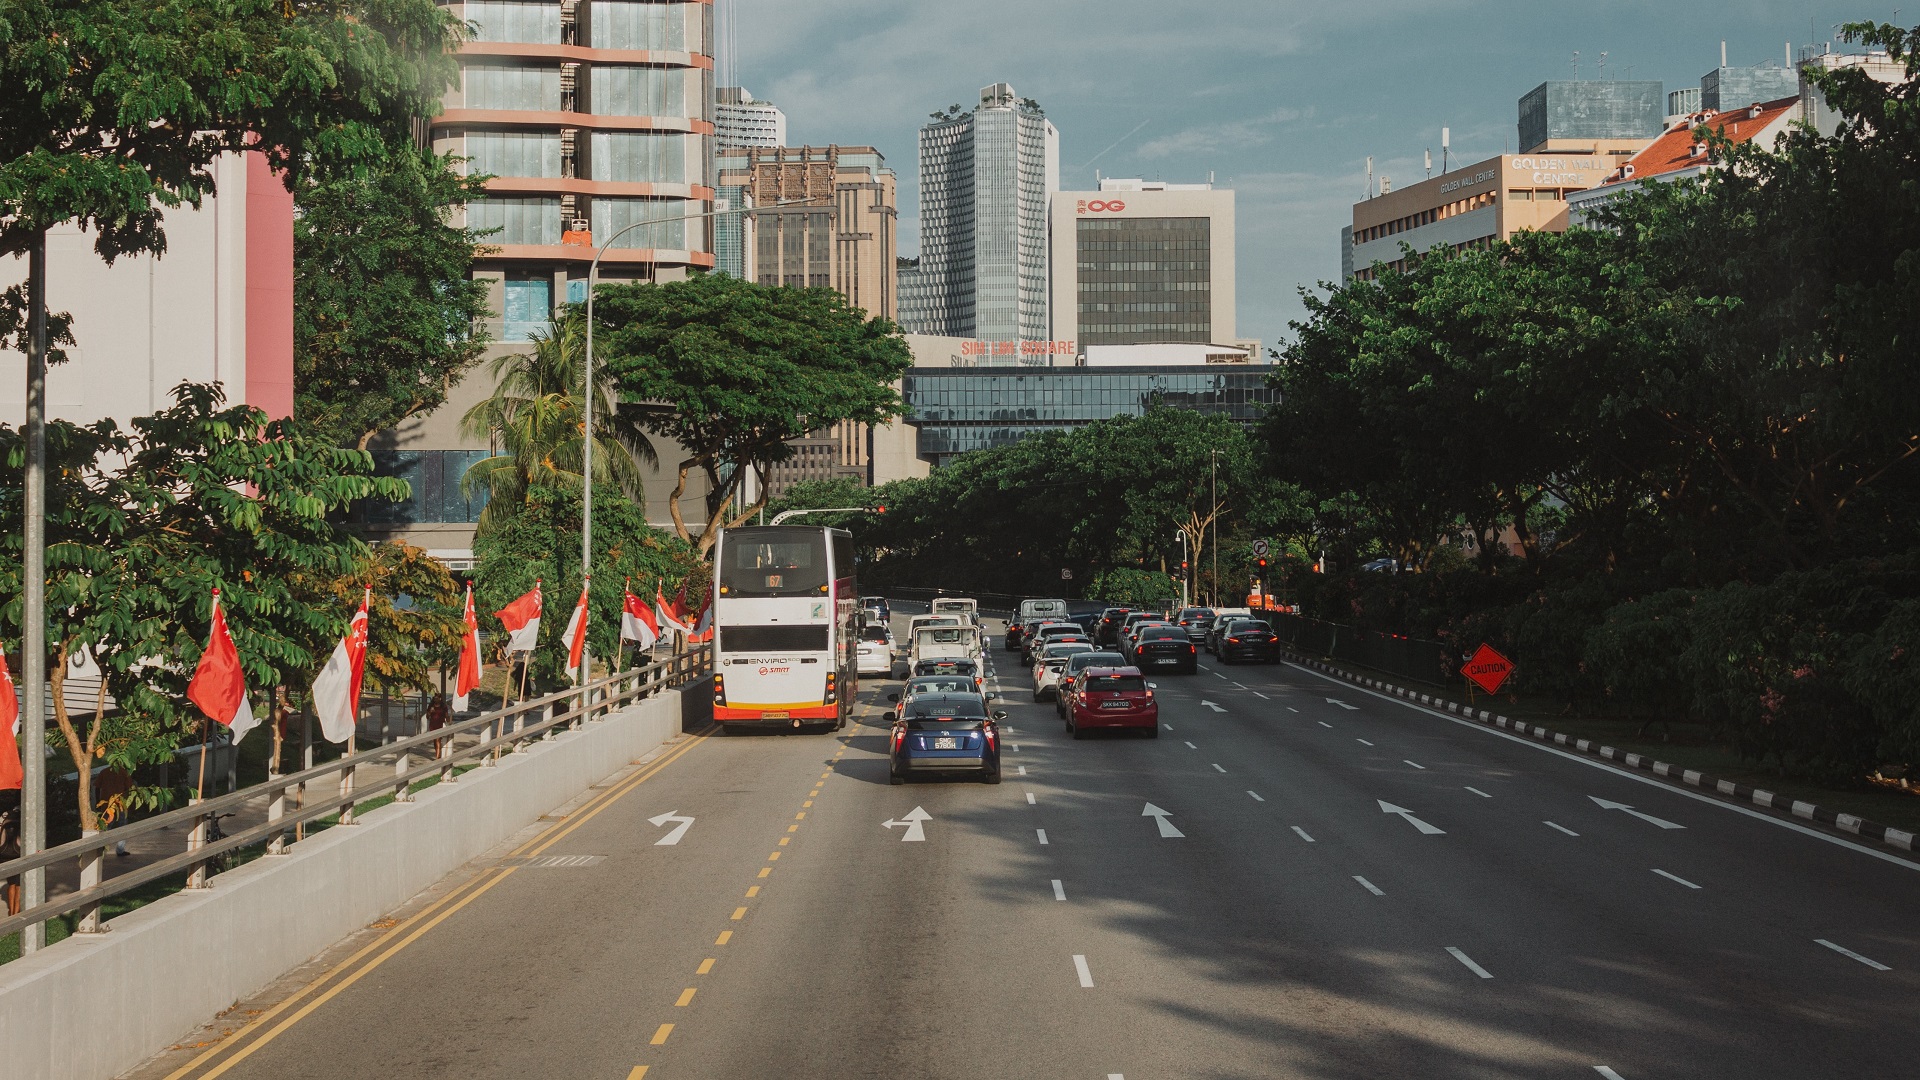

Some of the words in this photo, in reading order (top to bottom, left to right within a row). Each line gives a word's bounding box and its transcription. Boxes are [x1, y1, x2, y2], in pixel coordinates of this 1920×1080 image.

[1511, 157, 1566, 170] GOLDEN
[1571, 158, 1606, 170] WALL
[1440, 180, 1460, 194] GOLDEN
[1461, 176, 1475, 188] WALL
[1475, 169, 1495, 183] CENTRE
[1532, 171, 1584, 184] CENTRE
[1087, 199, 1126, 212] OG
[961, 340, 986, 356] SIM
[991, 340, 1015, 356] LIM
[1020, 340, 1075, 356] SQUARE
[769, 575, 781, 587] 67
[1470, 662, 1507, 675] CAUTION
